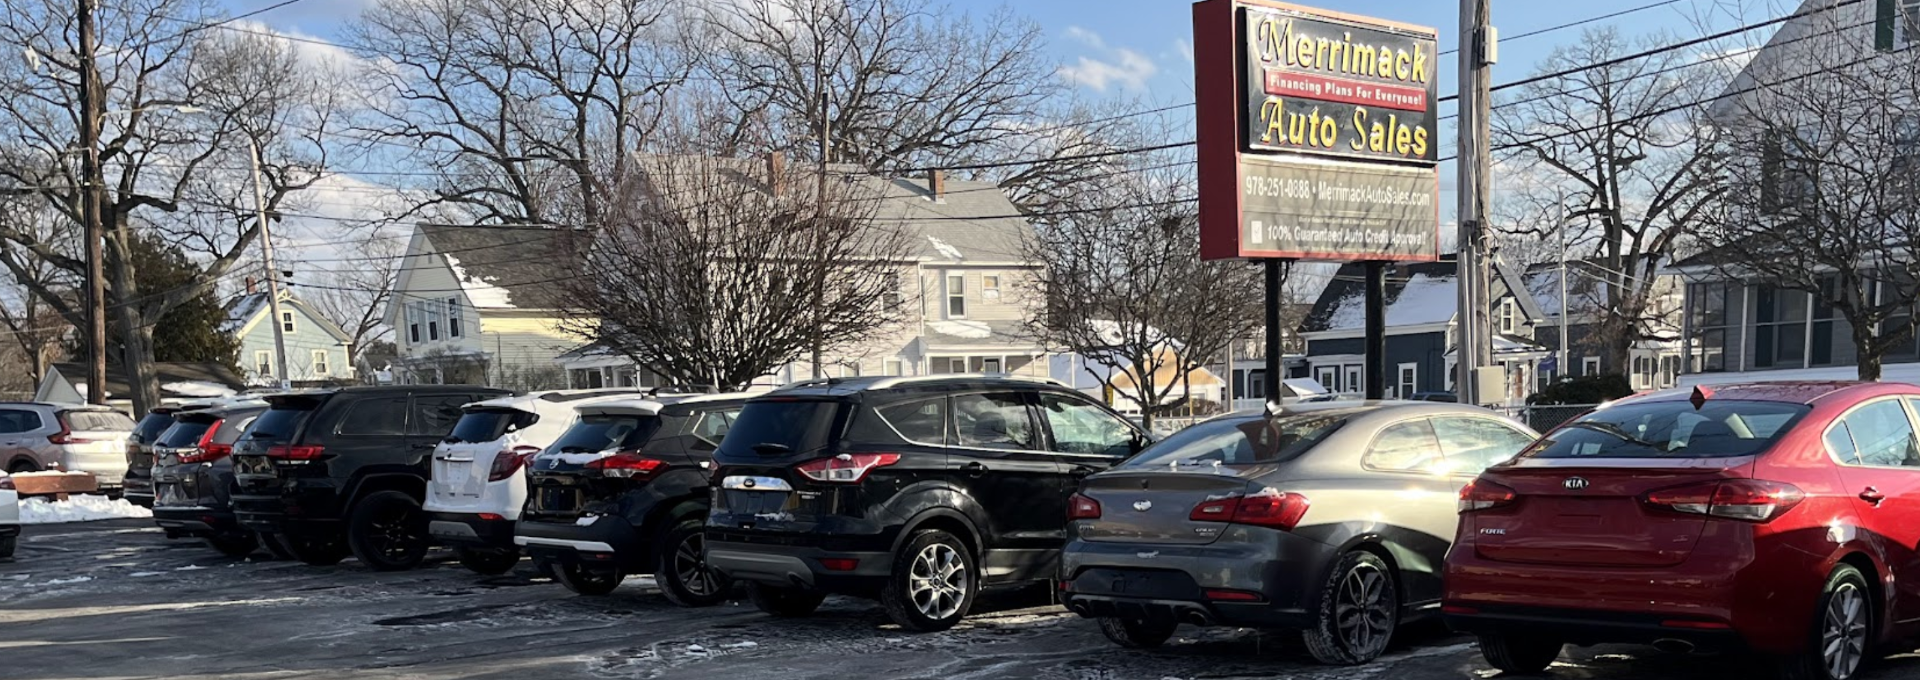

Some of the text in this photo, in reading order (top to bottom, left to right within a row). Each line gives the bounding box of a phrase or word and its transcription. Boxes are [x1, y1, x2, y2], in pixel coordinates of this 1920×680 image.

[1259, 14, 1426, 83] Merrimack
[1270, 74, 1422, 105] Financing Plans For Everyone!
[1260, 95, 1428, 157] Auto Sales
[1245, 175, 1430, 206] 978-251-0888 MerrimackAutoSales.com
[1267, 225, 1427, 247] 100% Guaranteed Auto Credit Approval!
